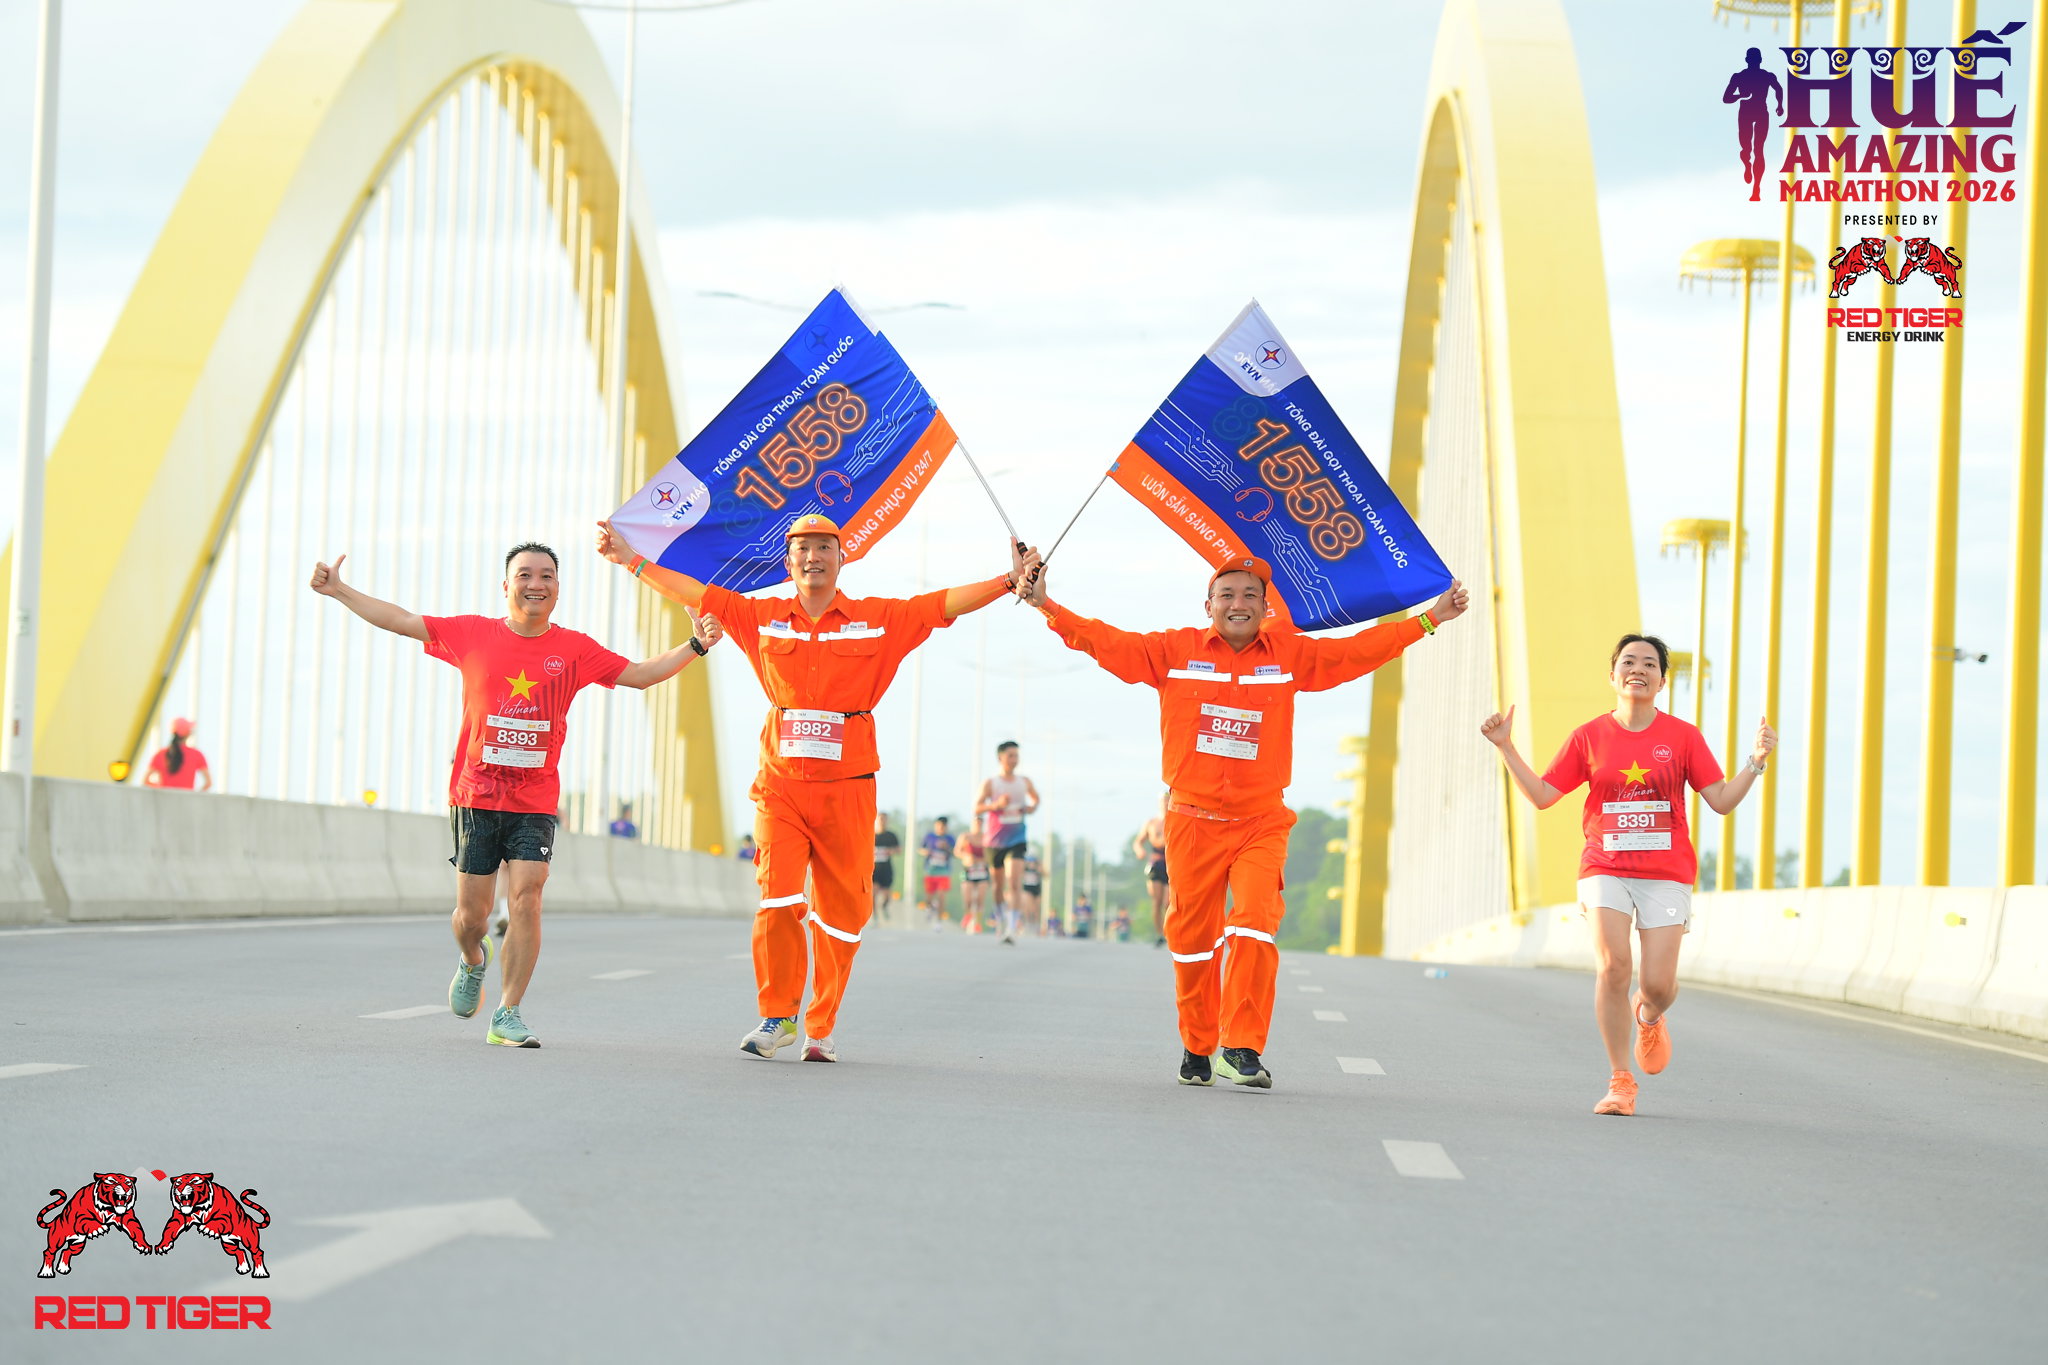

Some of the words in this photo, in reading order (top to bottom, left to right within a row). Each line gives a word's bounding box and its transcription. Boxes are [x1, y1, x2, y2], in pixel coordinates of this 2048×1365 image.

[1241, 362, 1262, 381] EVN
[739, 431, 759, 451] ĐÀI
[756, 413, 776, 433] GỌI
[772, 387, 805, 416] THOẠI
[801, 362, 830, 389] TOÀN
[827, 336, 854, 365] QUỐC
[734, 382, 867, 511] 1558
[846, 518, 880, 552] SÀNG
[874, 488, 906, 522] PHỤC
[900, 472, 918, 490] VỤ
[914, 450, 933, 476] 24/7
[1239, 418, 1366, 562] 1558
[1308, 430, 1328, 451] ĐÀI
[1324, 451, 1342, 471] GỌI
[1338, 470, 1366, 505] THOẠI
[1362, 504, 1388, 536] TOÀN
[1383, 535, 1408, 568] QUỐC
[672, 501, 692, 520] EVN
[1141, 474, 1170, 501] LUÔN
[1185, 512, 1216, 541] SÀNG
[497, 692, 541, 718] Vietnam
[496, 729, 538, 746] 8393
[792, 721, 832, 737] 8982
[1212, 718, 1251, 736] 8447
[1614, 783, 1656, 802] Vietnam
[1618, 814, 1655, 828] 8391
